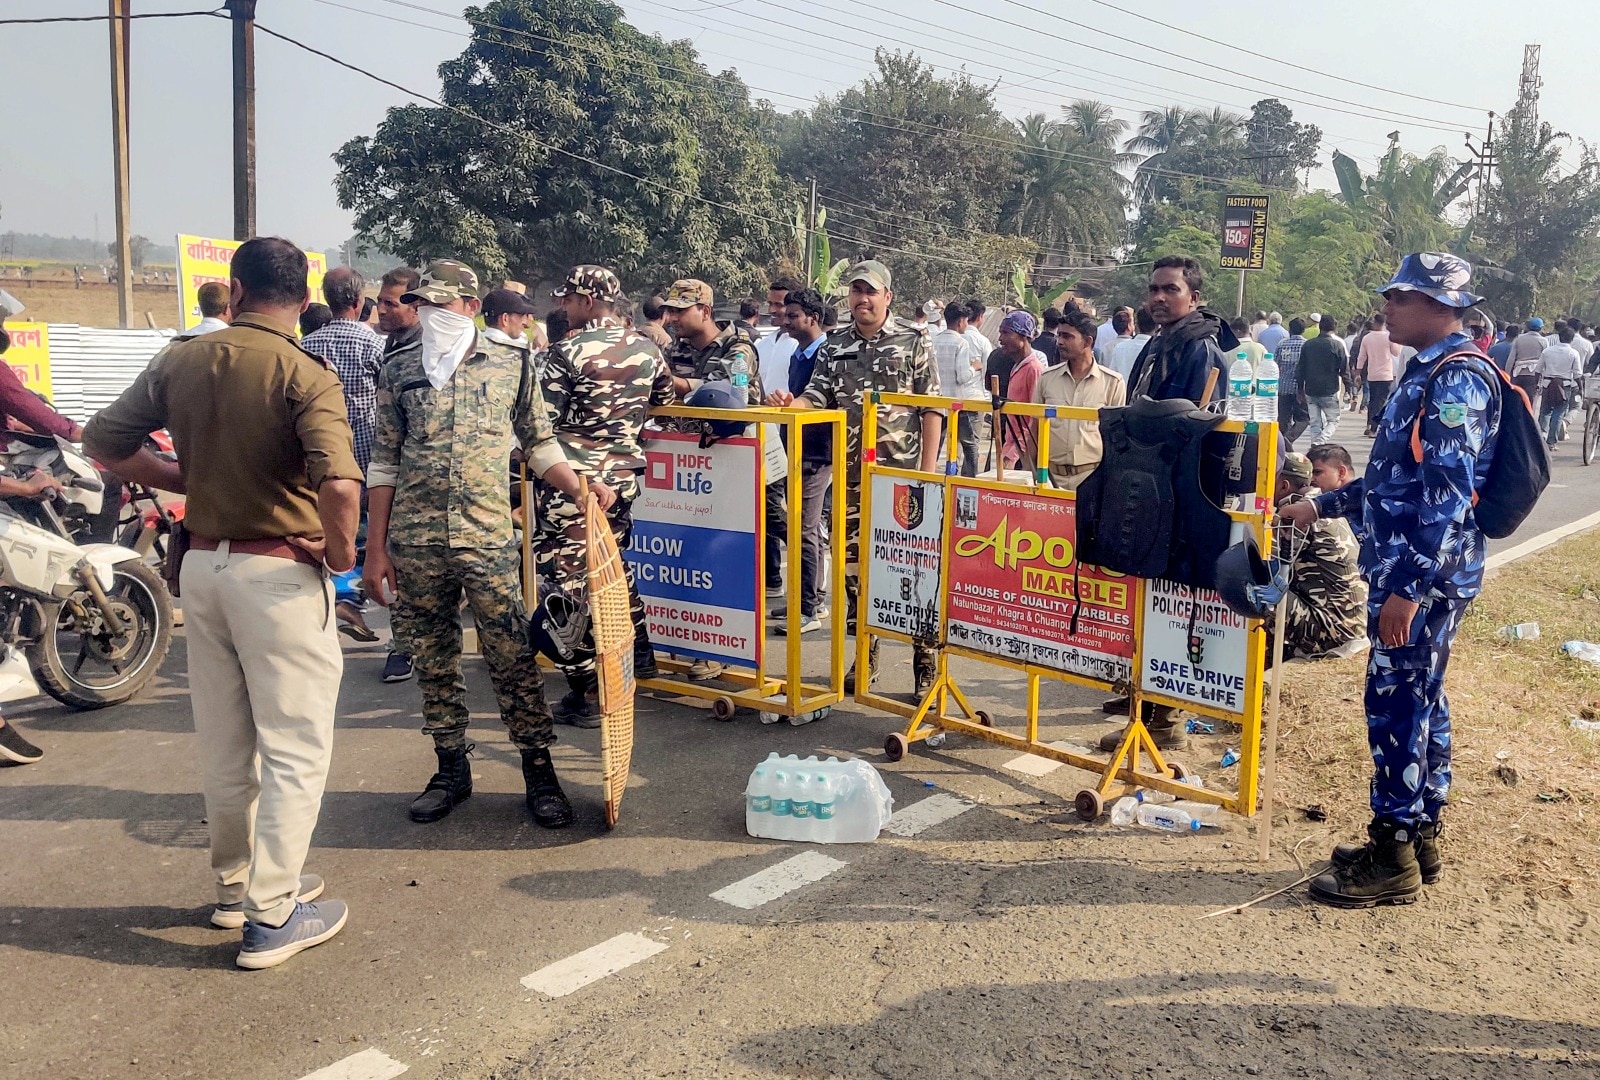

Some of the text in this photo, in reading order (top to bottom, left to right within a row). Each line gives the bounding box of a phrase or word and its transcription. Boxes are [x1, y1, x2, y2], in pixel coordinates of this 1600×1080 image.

[1227, 198, 1267, 207] FASTEST FOOD
[1254, 210, 1266, 226] Hut
[677, 454, 713, 471] HDFC
[676, 472, 713, 496] Life
[645, 497, 661, 507] Sar
[625, 534, 683, 557] OLLOW
[875, 544, 904, 563] POLICE
[659, 565, 713, 590] RULES
[1027, 571, 1123, 606] MARBLE
[954, 581, 962, 592] A
[964, 583, 1000, 599] HOUSE
[1003, 592, 1018, 602] OF
[1020, 595, 1069, 613] QUALITY
[1152, 596, 1191, 619] POLICE
[645, 605, 723, 627] AFFIC GUARD
[873, 597, 939, 622] SAFE DRIVE
[878, 612, 906, 628] SAVE
[953, 596, 1131, 643] Natunbazar, Khagra & Chuanpu Berhampore
[650, 623, 747, 650] POLICE DISTRICT
[1150, 658, 1244, 691] SAFE DRIVE
[1155, 675, 1236, 706] SAVE LIFE
